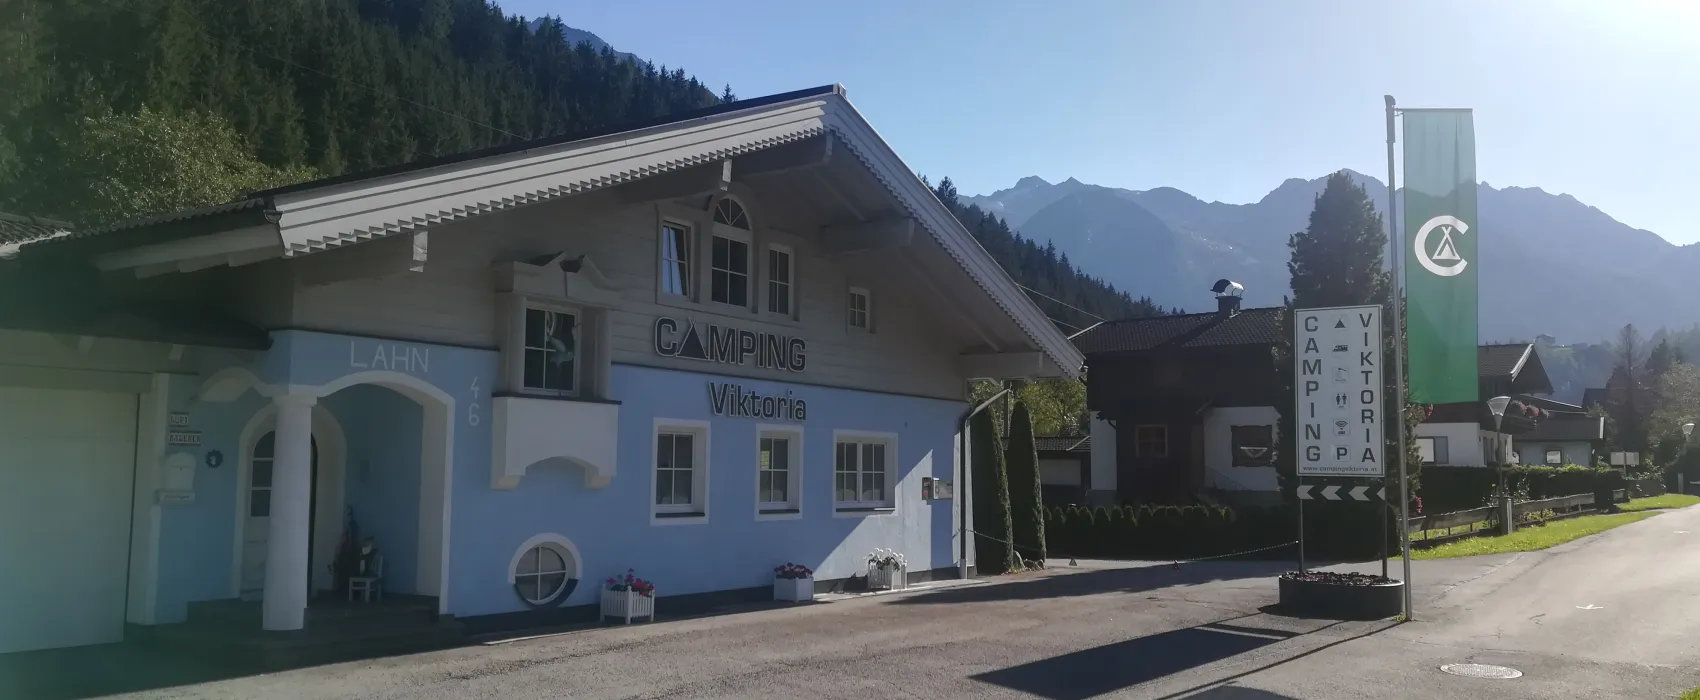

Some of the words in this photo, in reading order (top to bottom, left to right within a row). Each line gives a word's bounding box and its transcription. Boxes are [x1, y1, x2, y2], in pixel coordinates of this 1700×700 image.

[351, 340, 429, 372] LAHN
[655, 316, 807, 372] CAMPING
[708, 382, 807, 421] Viktoria
[1303, 316, 1321, 461] CAMPING
[1359, 313, 1375, 462] VIKTORIA
[1336, 447, 1348, 460] P
